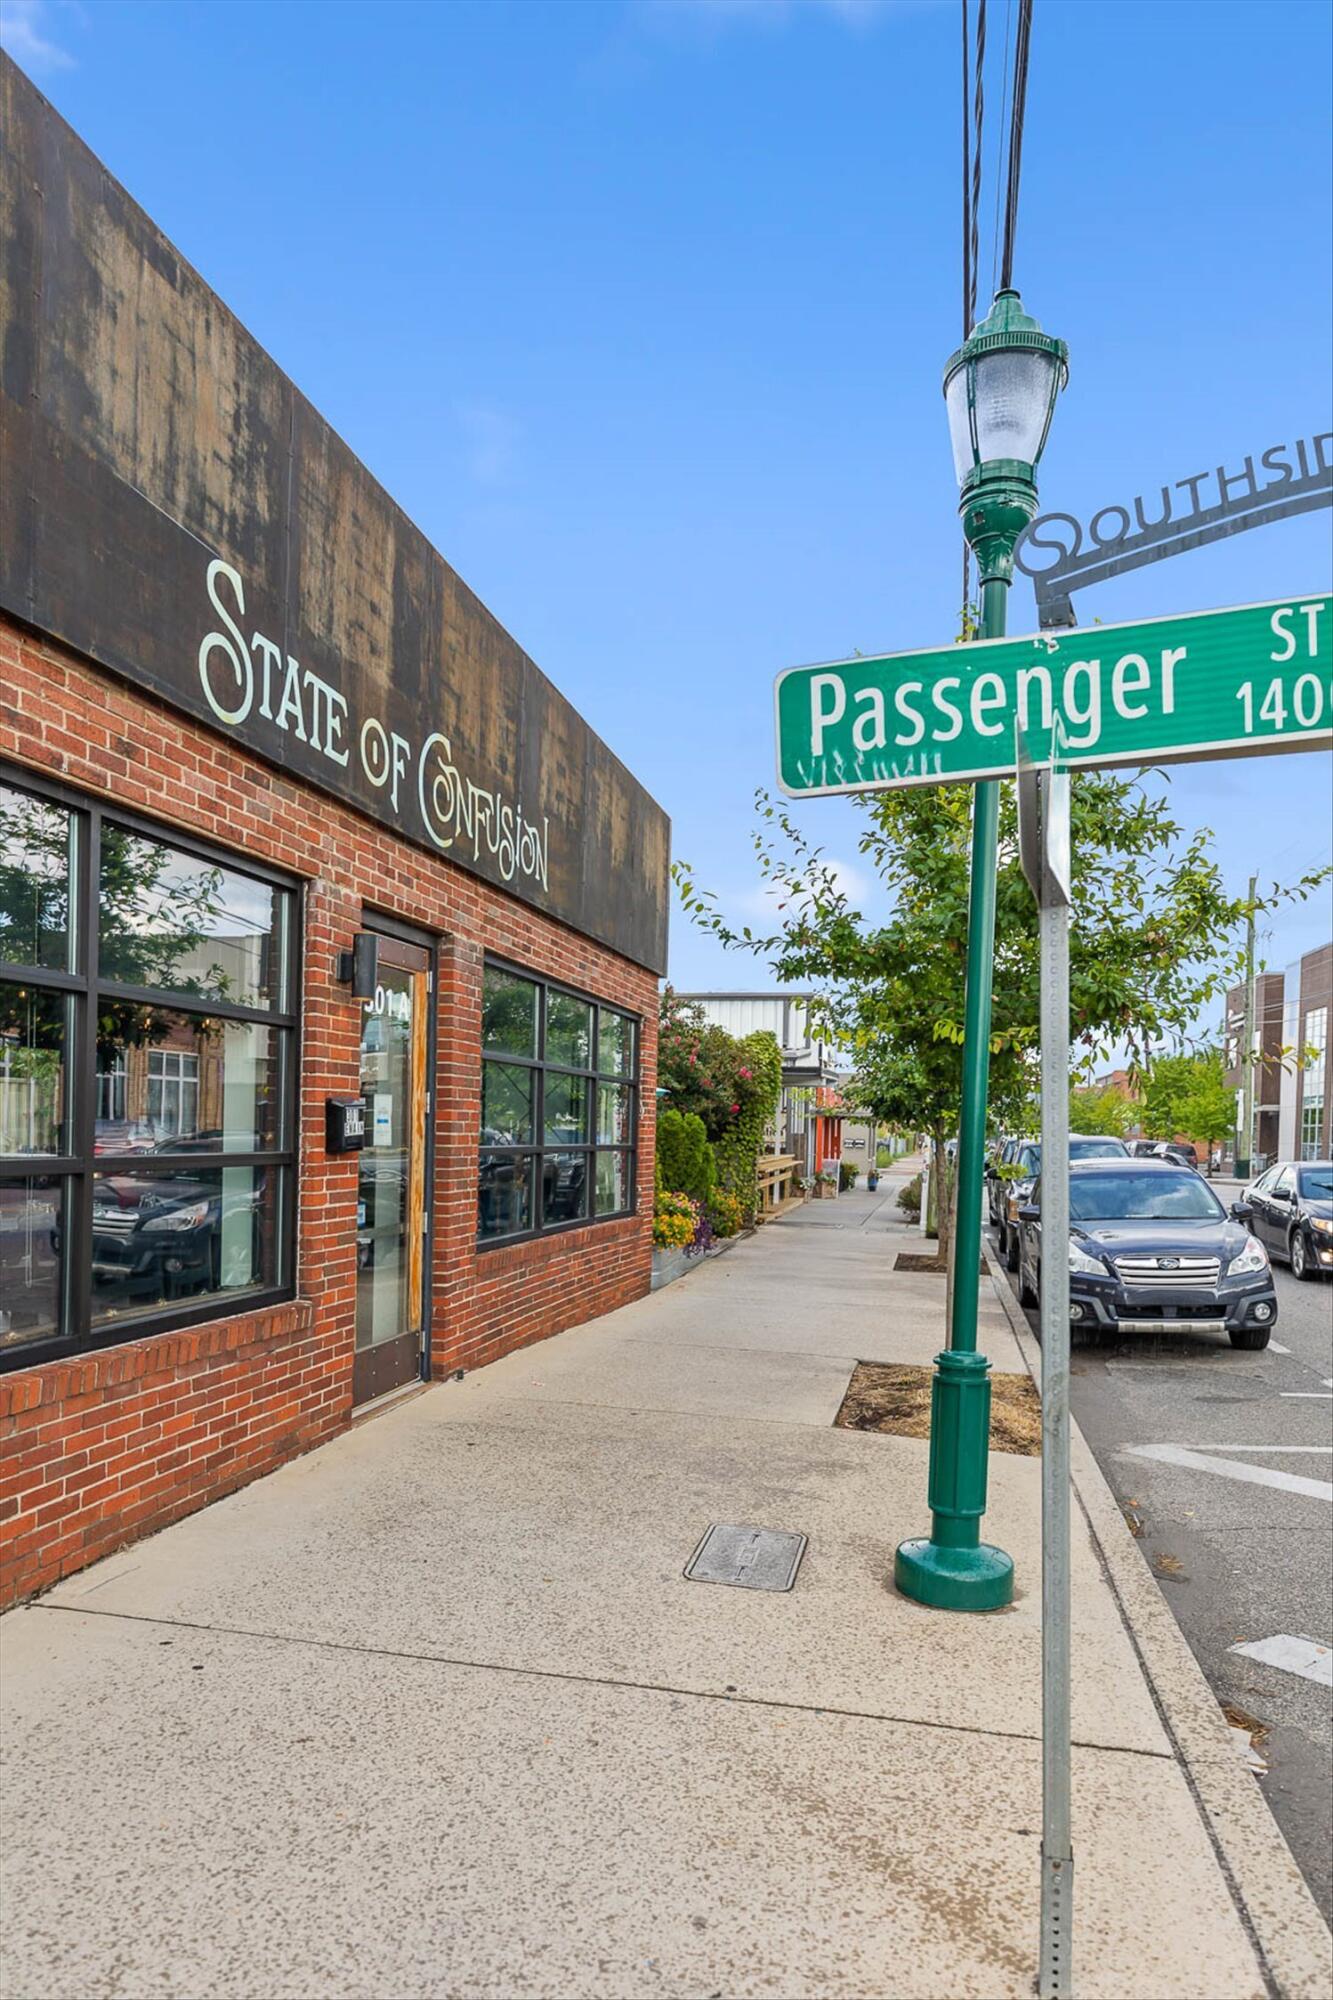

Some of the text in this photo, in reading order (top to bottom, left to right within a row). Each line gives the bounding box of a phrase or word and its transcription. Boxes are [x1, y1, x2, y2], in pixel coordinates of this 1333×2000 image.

[199, 559, 349, 767] STATE
[360, 717, 411, 813] OF
[809, 603, 1325, 756] Passenger ST
[1236, 673, 1333, 733] 140
